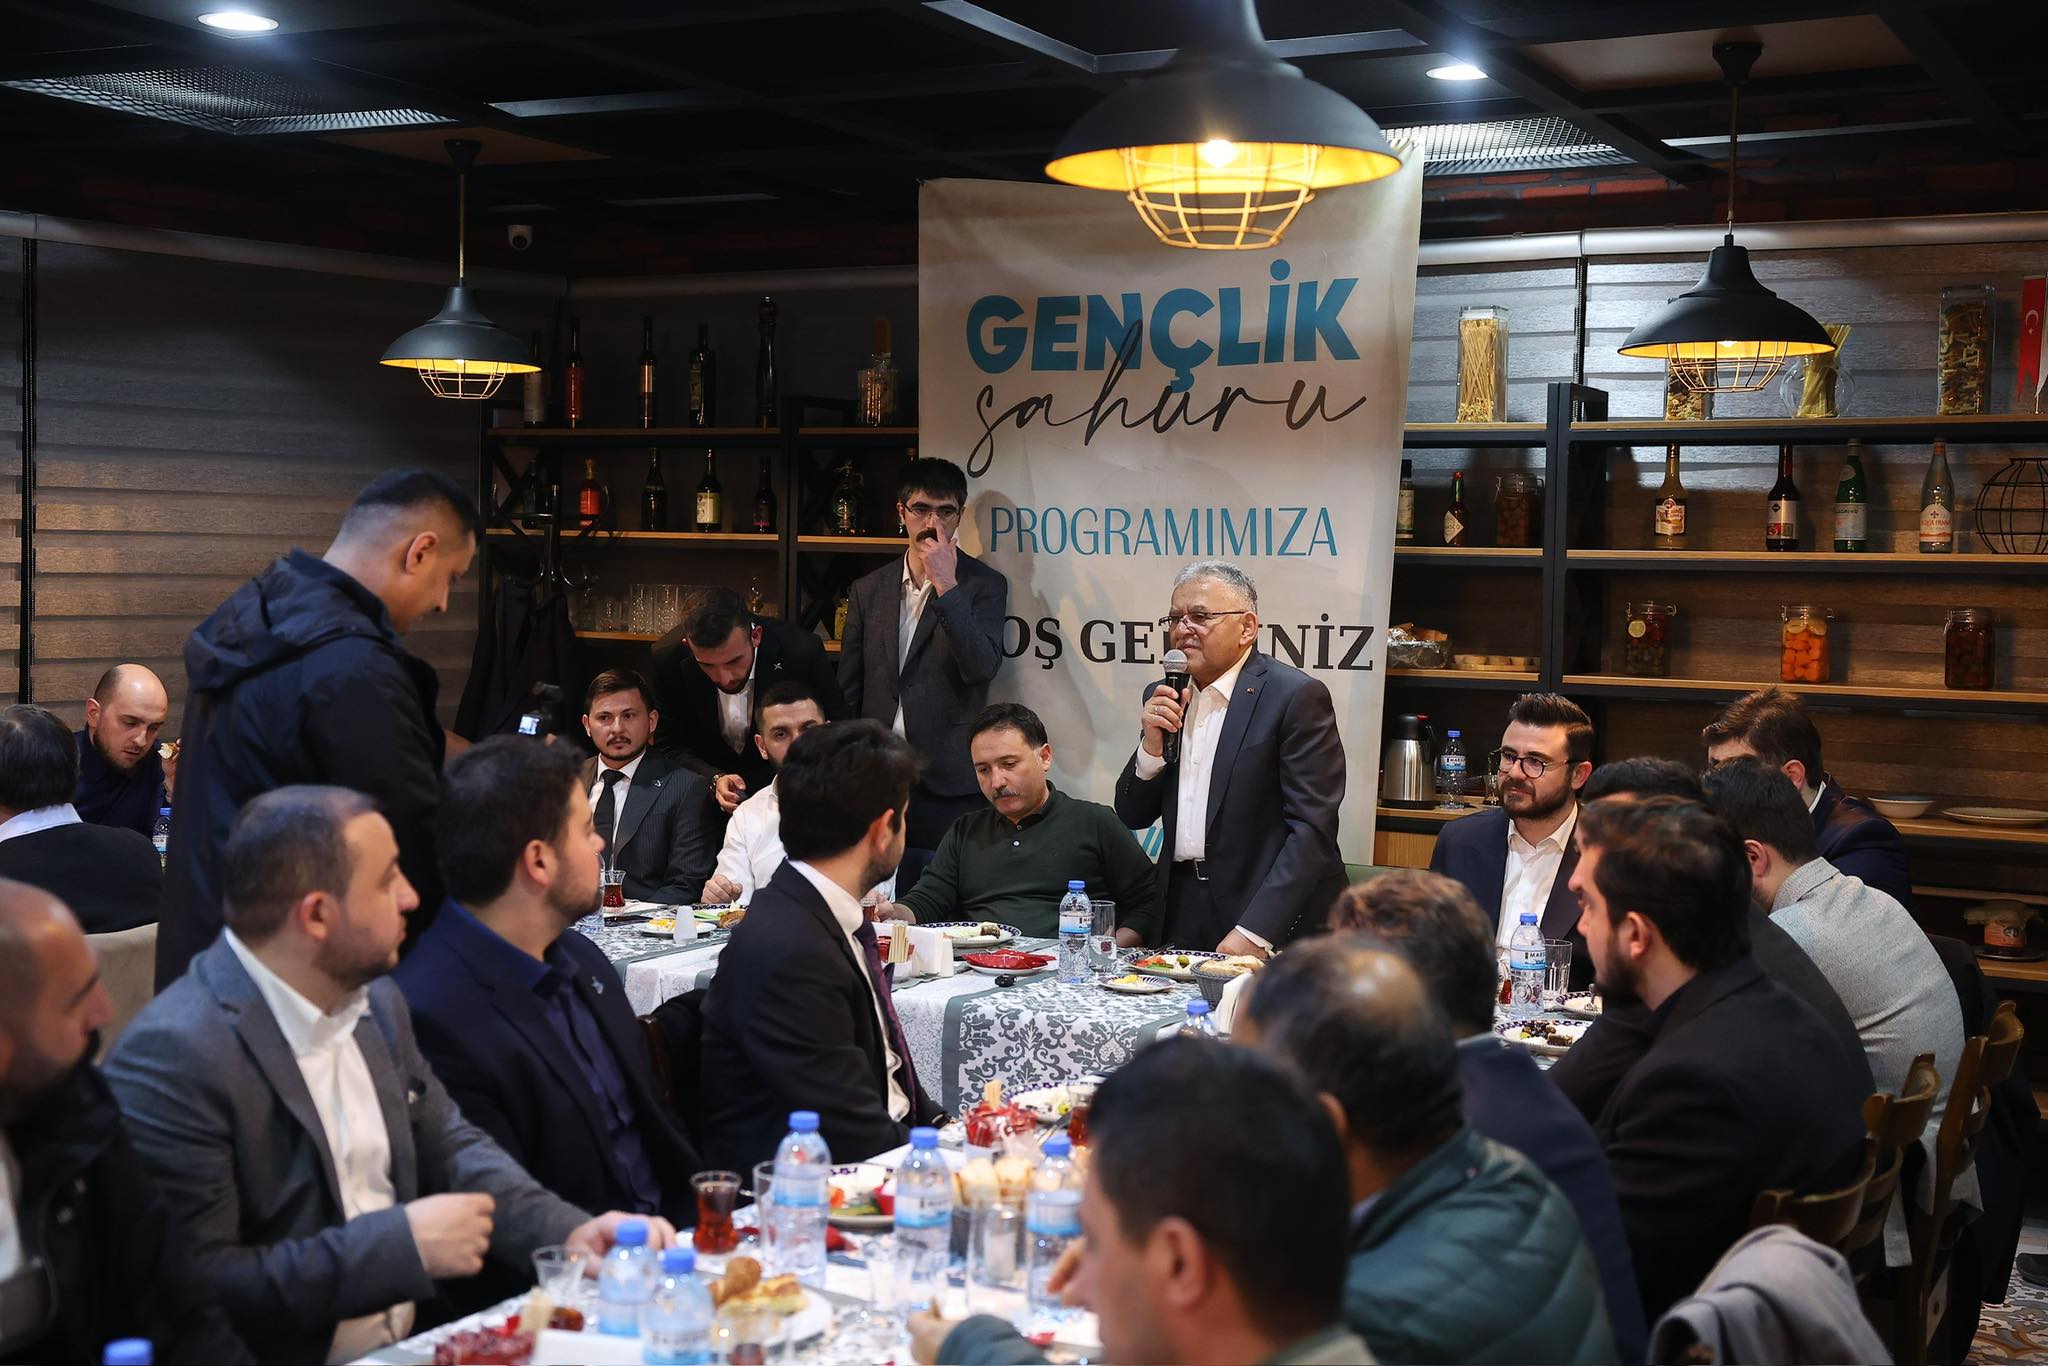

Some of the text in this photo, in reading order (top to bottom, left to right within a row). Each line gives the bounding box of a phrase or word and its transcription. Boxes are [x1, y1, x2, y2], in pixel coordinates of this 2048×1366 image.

[966, 259, 1360, 393] GENÇLİK
[966, 318, 1367, 478] sahuru
[990, 506, 1338, 556] PROGRAMIMIZA
[1001, 613, 1374, 671] OŞ GENİZ
